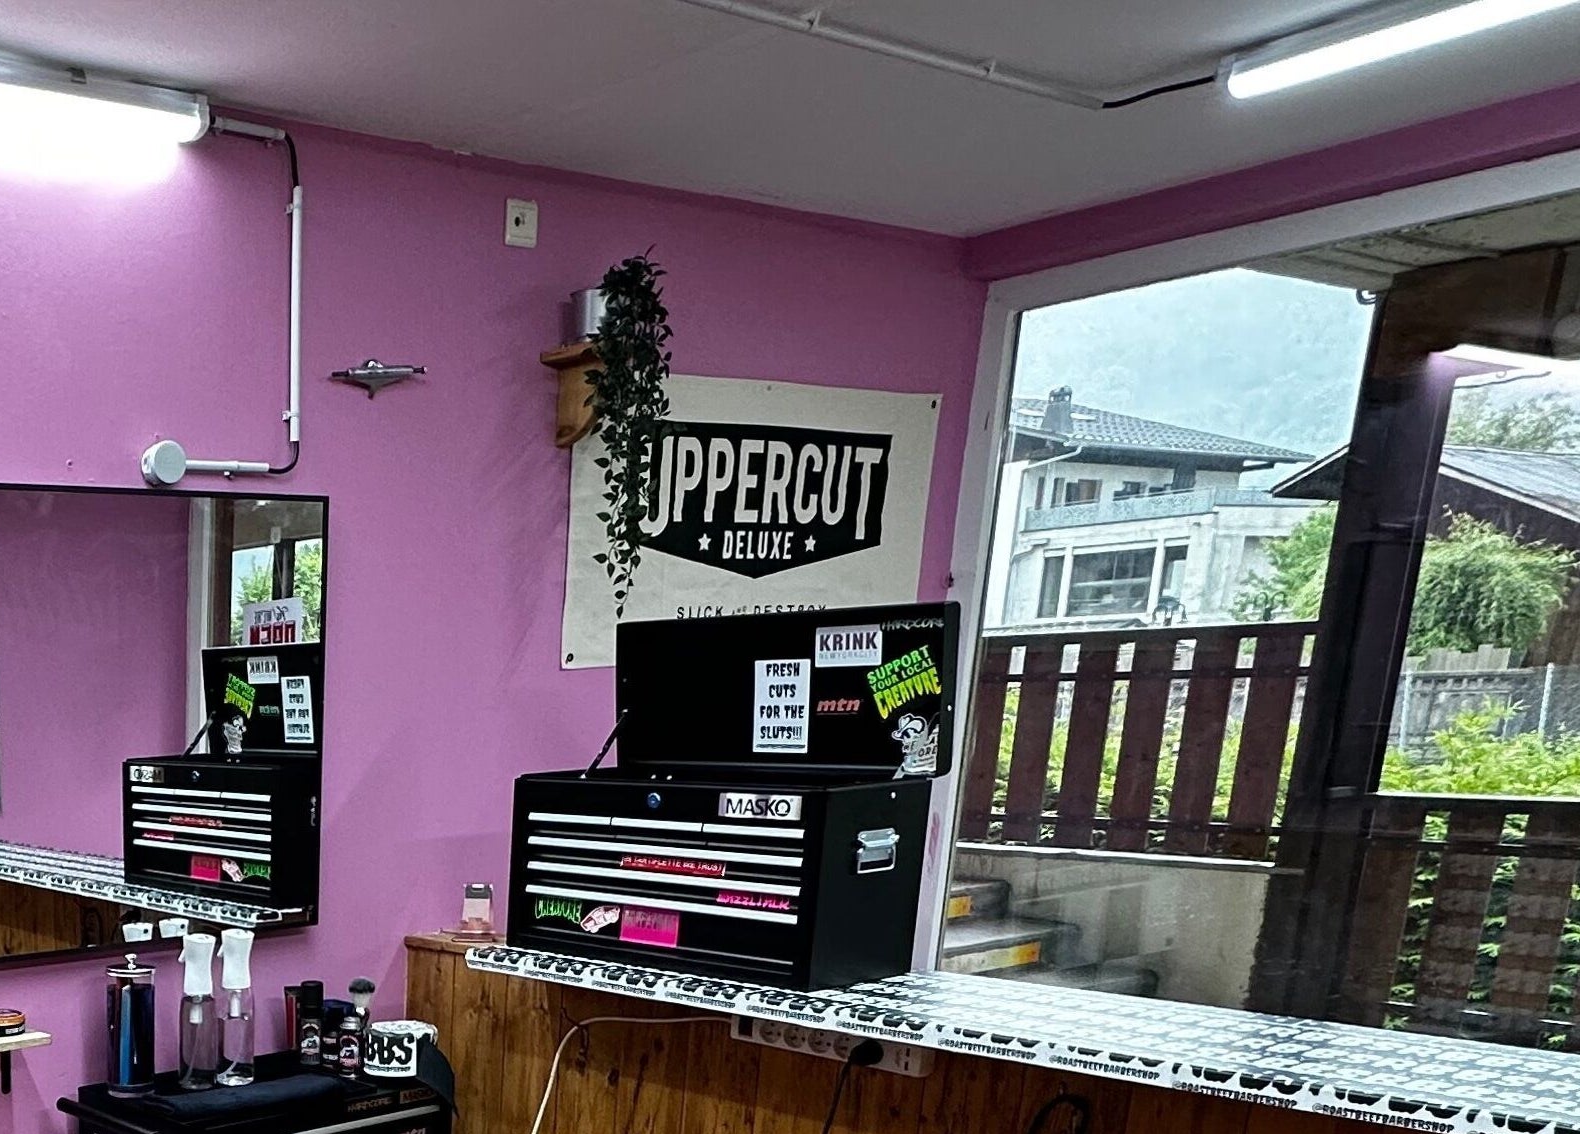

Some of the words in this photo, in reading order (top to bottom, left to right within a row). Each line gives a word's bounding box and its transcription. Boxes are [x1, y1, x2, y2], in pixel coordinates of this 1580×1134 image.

[722, 530, 794, 560] DELUXE
[819, 631, 878, 651] KRINK
[766, 662, 800, 677] FRESH
[867, 644, 929, 685] SUPPORT
[870, 672, 899, 693] YOUR
[900, 659, 935, 679] LOCAL
[768, 684, 796, 698] CUTS
[873, 666, 942, 720] CREATURE
[759, 705, 780, 719] FOR
[784, 704, 805, 719] THE
[816, 698, 861, 712] mtn
[725, 798, 792, 817] MASKO
